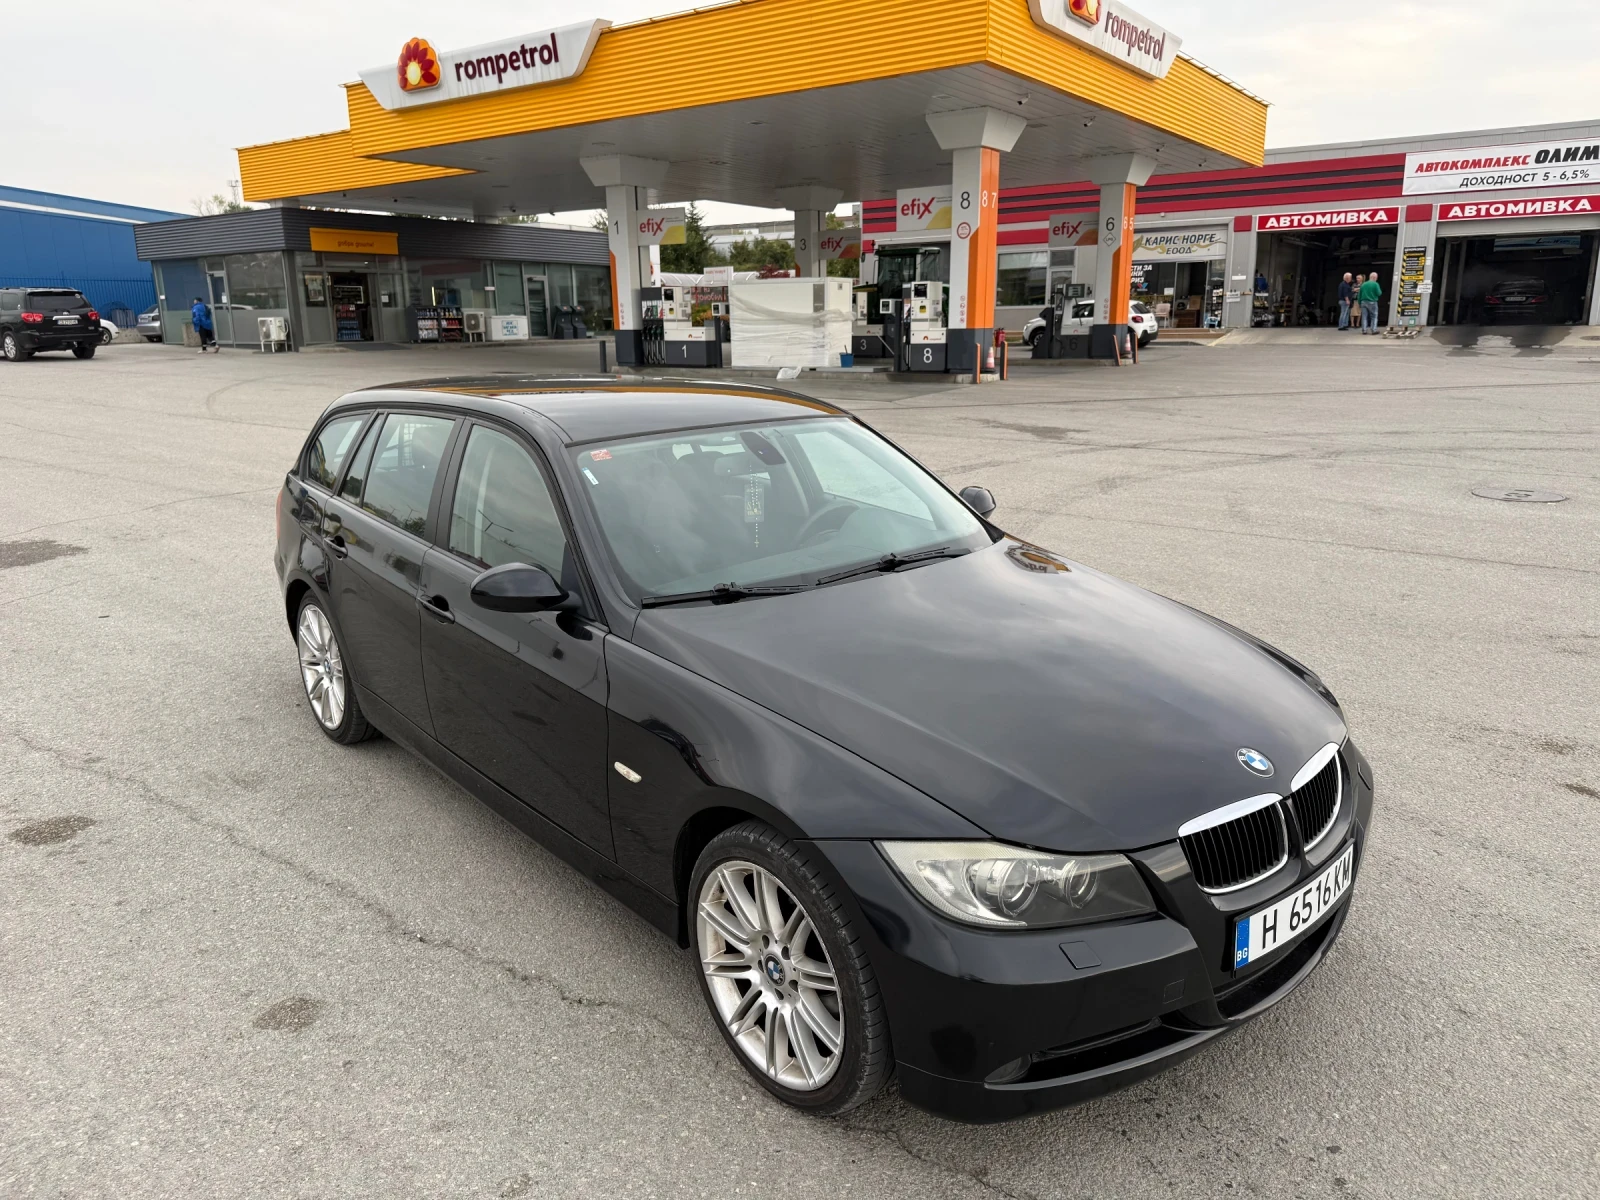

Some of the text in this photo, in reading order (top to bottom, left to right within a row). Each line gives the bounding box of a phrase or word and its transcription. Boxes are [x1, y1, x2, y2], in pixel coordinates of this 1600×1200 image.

[1105, 11, 1166, 61] rompetrol
[455, 33, 559, 83] rompetrol
[1415, 154, 1531, 174] АВТОКОМПЛЕКС
[1459, 173, 1538, 188] ДОХОДНОСТ
[1542, 172, 1551, 181] 5
[1560, 169, 1590, 181] 6,5%
[960, 191, 970, 209] 8
[982, 190, 997, 208] 8 7
[901, 197, 935, 219] efix
[1448, 198, 1592, 218] АВТОМИВКА
[613, 220, 619, 234] 1
[640, 218, 665, 236] efix
[1105, 217, 1115, 231] 6
[1123, 216, 1134, 230] 6 5
[1265, 209, 1389, 228] АВТОМИВКА
[1052, 221, 1082, 238] efix
[800, 238, 807, 251] 3
[820, 237, 844, 252] efix
[1145, 233, 1217, 246] КАРИС НОРГЕ
[1166, 246, 1192, 255] ЕООД
[681, 344, 687, 358] 1
[860, 340, 867, 350] 3
[923, 348, 933, 363] 8
[1262, 850, 1351, 949] H 6516 KM
[1237, 948, 1248, 961] BG
